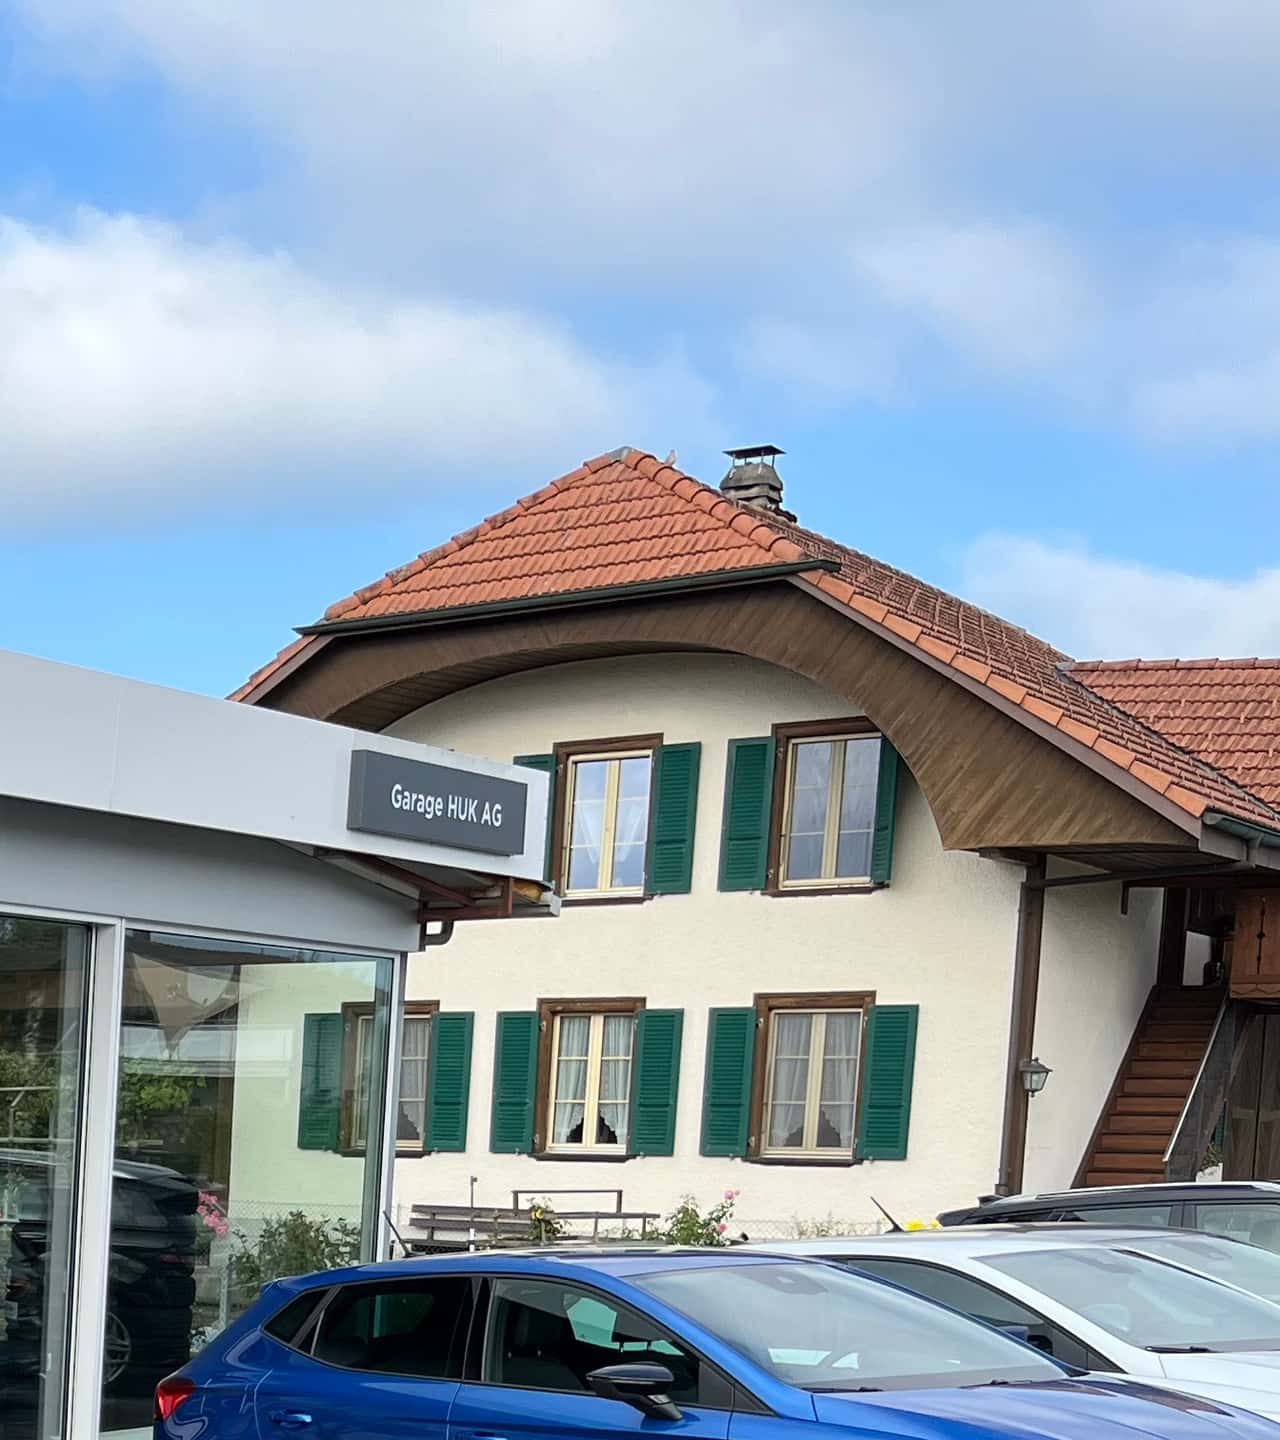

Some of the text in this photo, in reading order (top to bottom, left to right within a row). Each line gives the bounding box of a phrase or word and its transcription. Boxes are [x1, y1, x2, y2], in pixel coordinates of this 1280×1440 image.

[391, 783, 502, 827] Garage HUK AG
